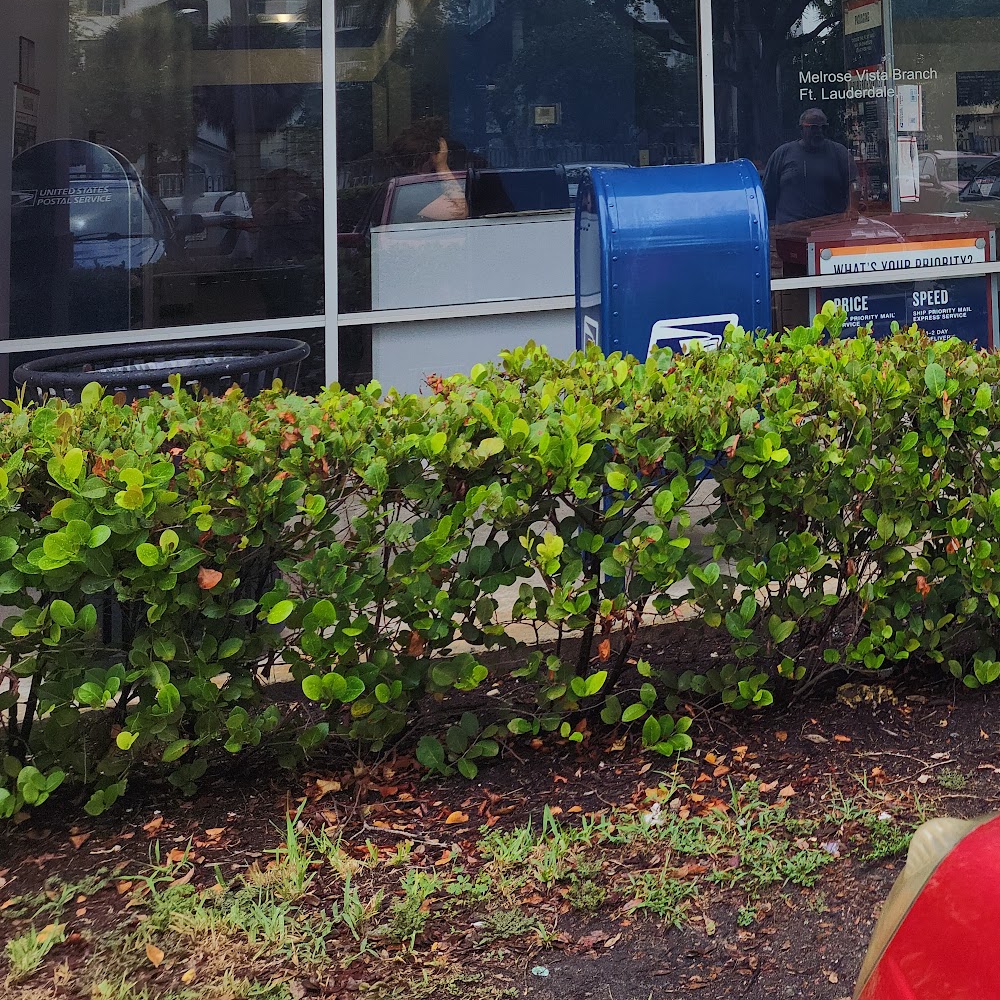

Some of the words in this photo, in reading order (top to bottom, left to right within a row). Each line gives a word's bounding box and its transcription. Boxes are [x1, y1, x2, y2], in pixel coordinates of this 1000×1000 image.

[799, 70, 852, 84] Melrose
[855, 69, 888, 81] Vista
[893, 67, 938, 80] Branch
[800, 88, 817, 101] Ft.
[39, 188, 75, 197] UNITED
[74, 186, 109, 194] STATES
[37, 198, 72, 206] POSTAL
[73, 195, 112, 204] SERVICE
[834, 260, 877, 274] WHAT'S
[881, 258, 911, 271] YOUR
[916, 254, 973, 269] PRIORITY?
[912, 289, 949, 307] SPEED
[834, 296, 869, 313] PRICE
[928, 307, 956, 315] PRIORITY
[941, 312, 967, 320] SERVICE
[850, 314, 879, 322] PRIORITY
